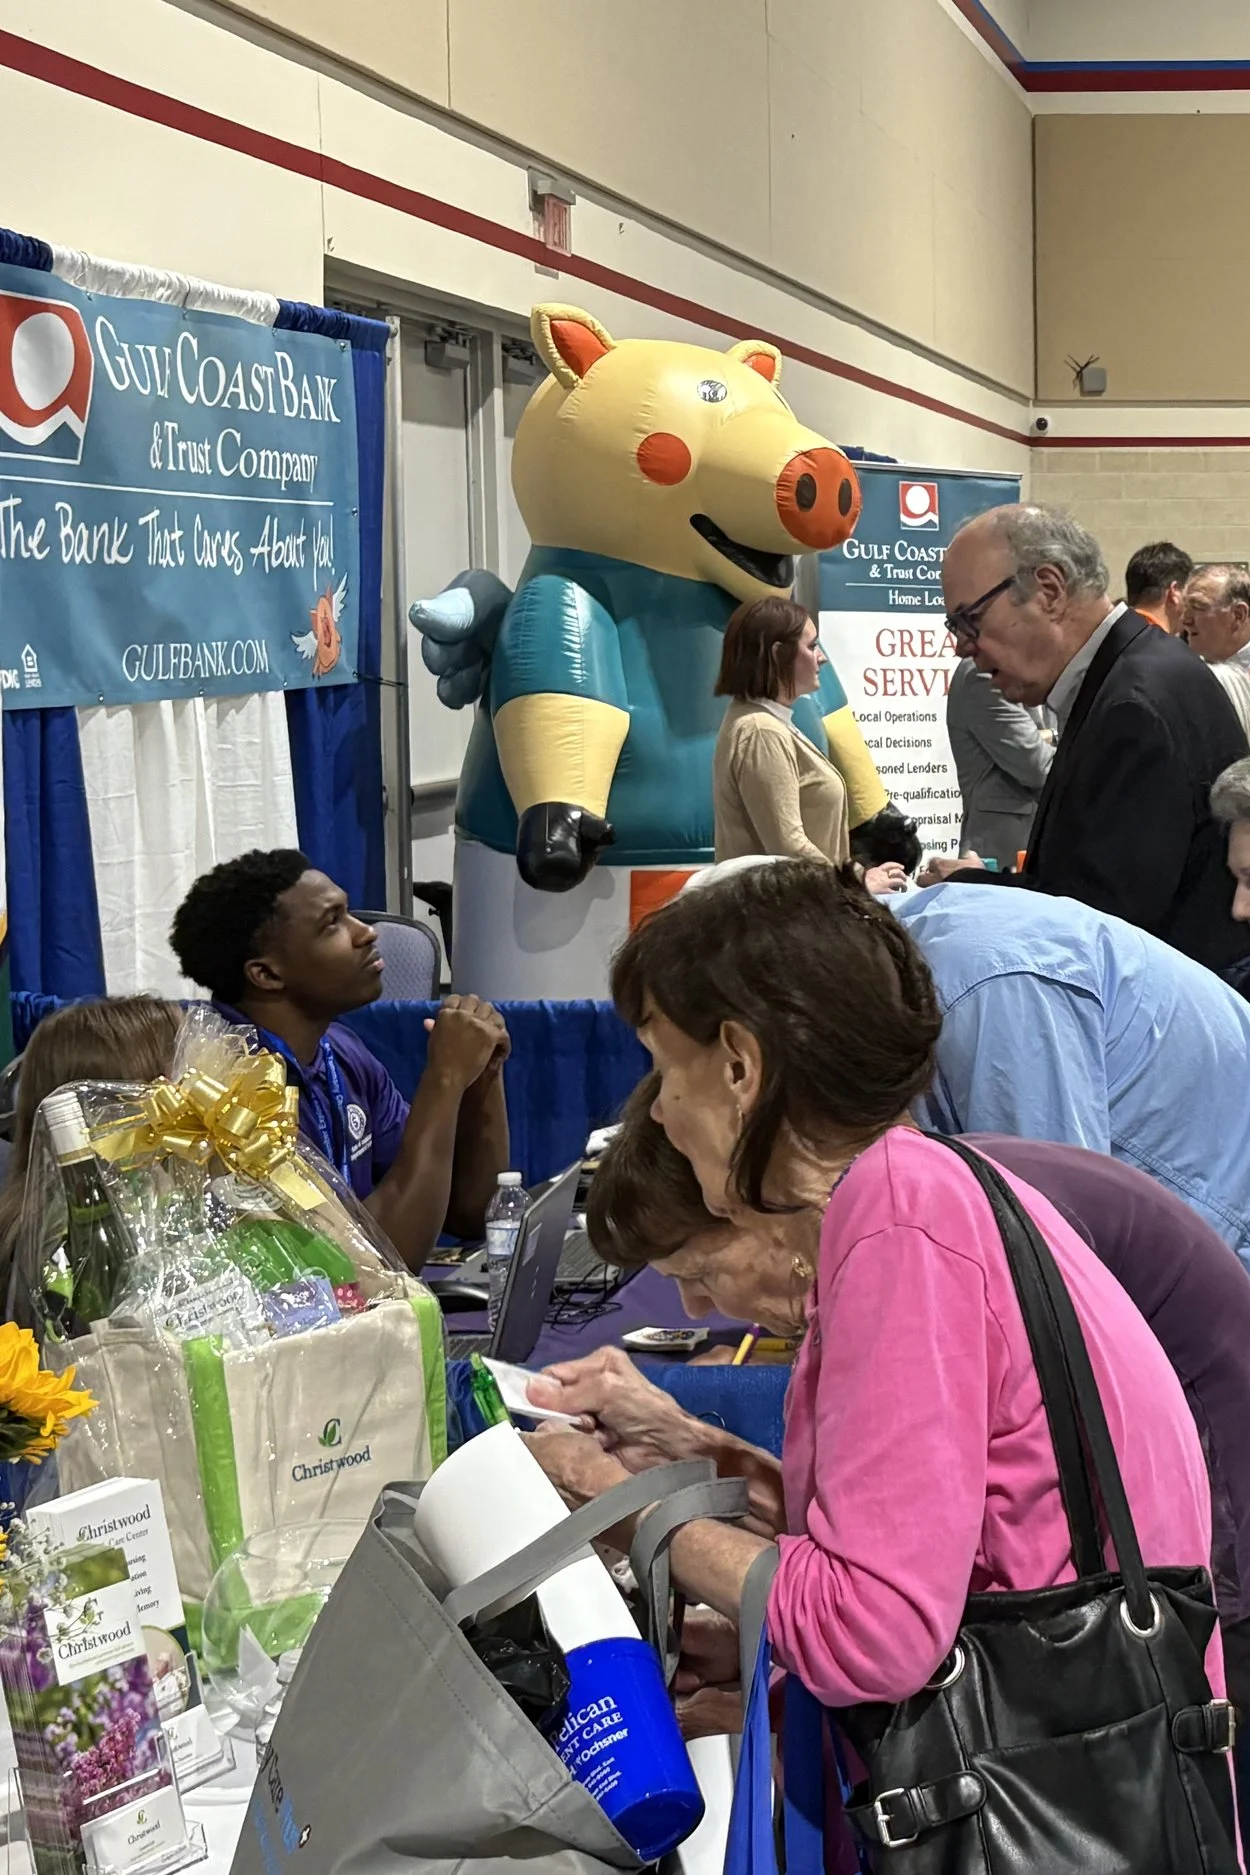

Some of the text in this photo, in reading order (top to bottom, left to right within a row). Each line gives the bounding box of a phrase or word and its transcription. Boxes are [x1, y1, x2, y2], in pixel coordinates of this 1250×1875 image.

[216, 428, 318, 493] Company
[0, 497, 50, 560] The
[55, 501, 134, 565] Bank
[139, 509, 184, 569] That
[193, 514, 244, 576] Cares
[249, 514, 306, 574] About
[883, 563, 914, 579] Trust
[889, 589, 921, 606] Home
[122, 639, 270, 682] GULFBANK.COM
[0, 669, 20, 690] DIC
[884, 711, 938, 725] Operations
[885, 737, 933, 749] Decisions
[907, 763, 948, 775] Lenders
[291, 1444, 372, 1483] Christwood
[77, 1504, 151, 1542] Christwood
[58, 1621, 131, 1660] Christwood
[582, 1711, 624, 1740] CARE
[580, 1727, 629, 1763] Ochsner
